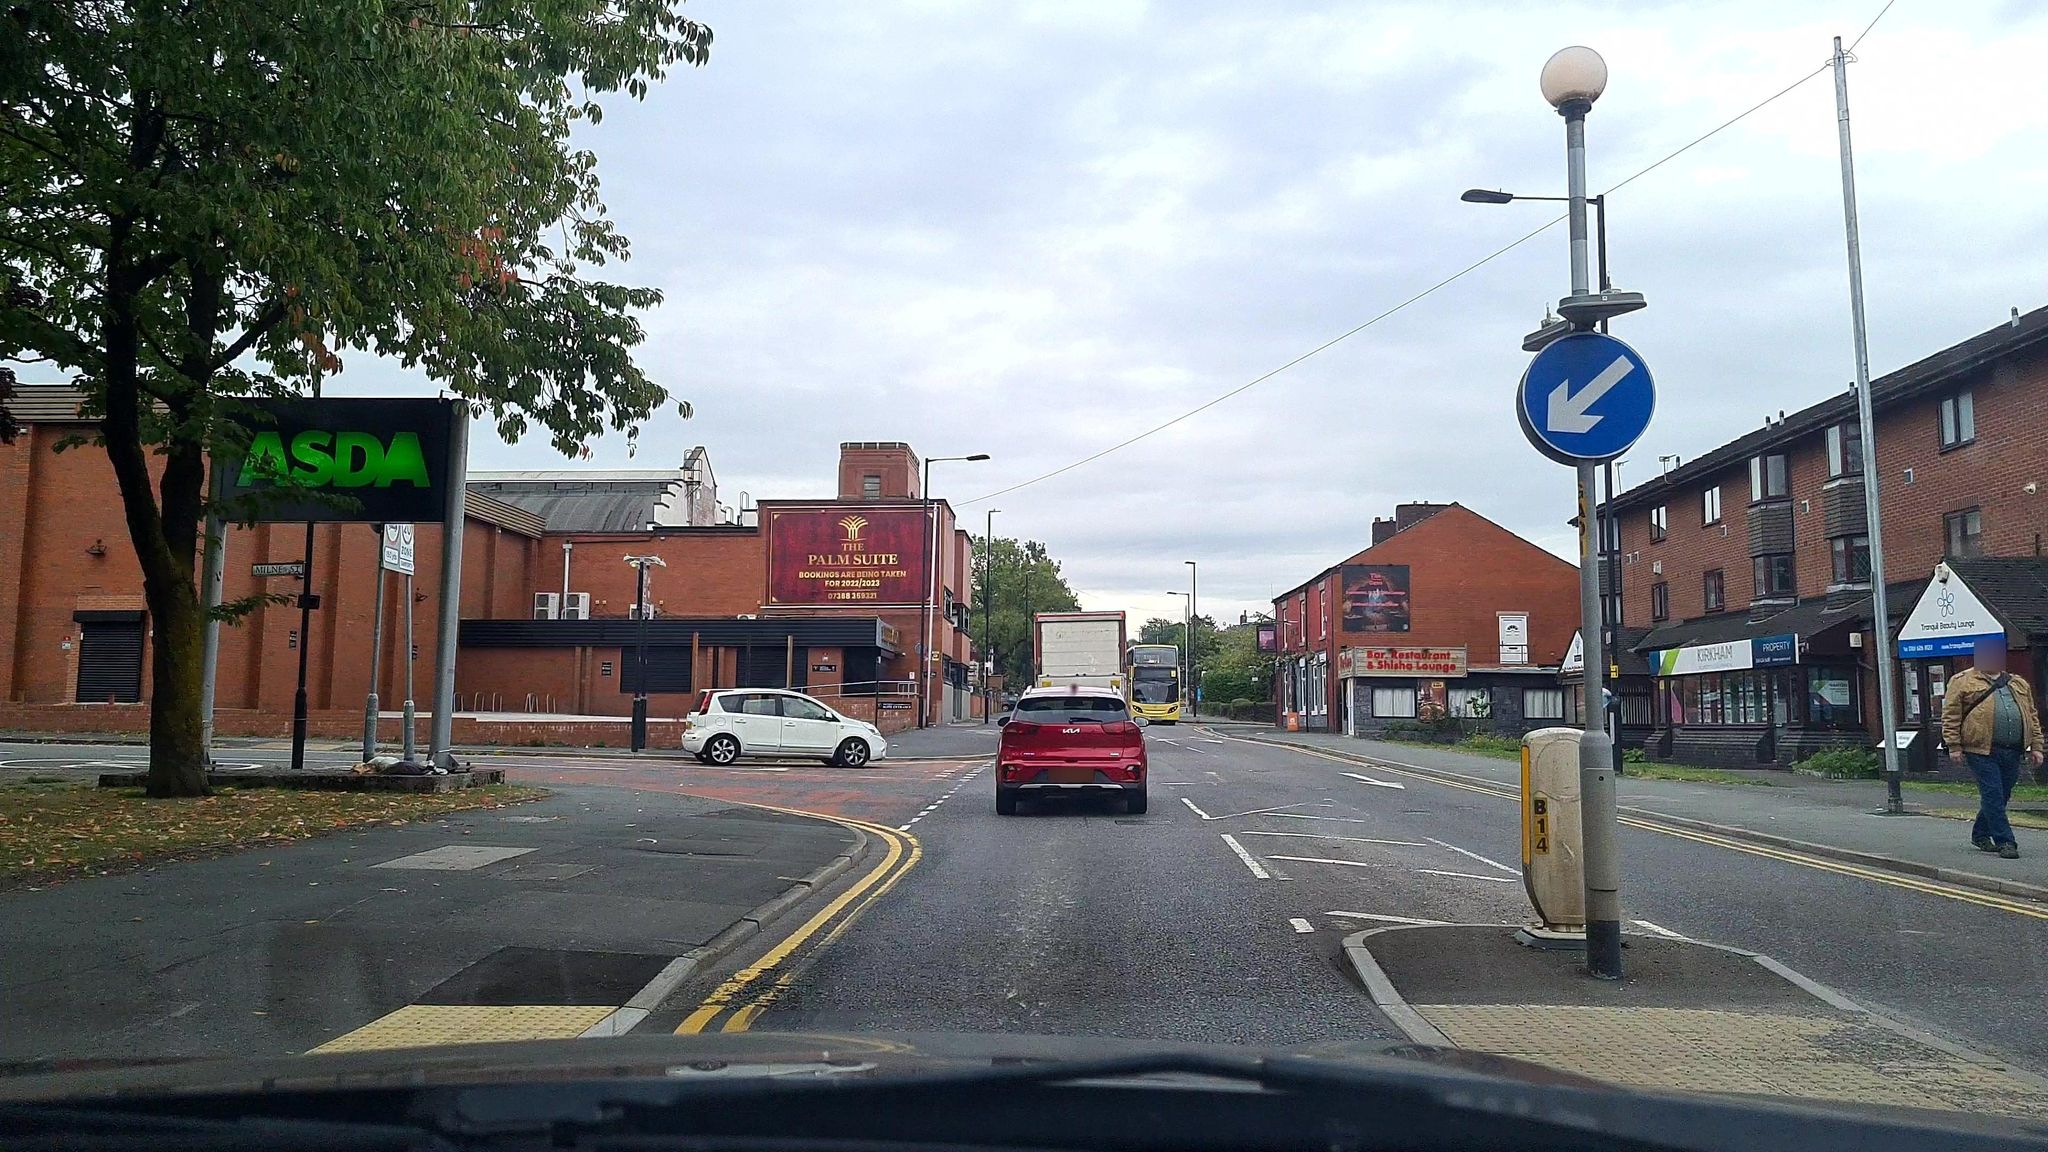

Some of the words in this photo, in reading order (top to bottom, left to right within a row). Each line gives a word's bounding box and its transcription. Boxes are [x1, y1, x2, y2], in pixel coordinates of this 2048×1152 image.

[236, 430, 431, 487] ASDA
[402, 546, 412, 558] ZONE
[808, 554, 849, 565] PALM
[853, 554, 898, 565] SUITE
[841, 580, 880, 588] 2022/2023
[1921, 623, 1938, 631] Tranquil
[1762, 641, 1790, 652] PROPERTY
[1391, 651, 1451, 660] Restaurant
[1698, 644, 1733, 662] KIRKHAM
[1367, 662, 1374, 670] &
[1377, 661, 1412, 670] Shisha
[1416, 663, 1456, 672] Lounge
[1534, 800, 1548, 852] B14
